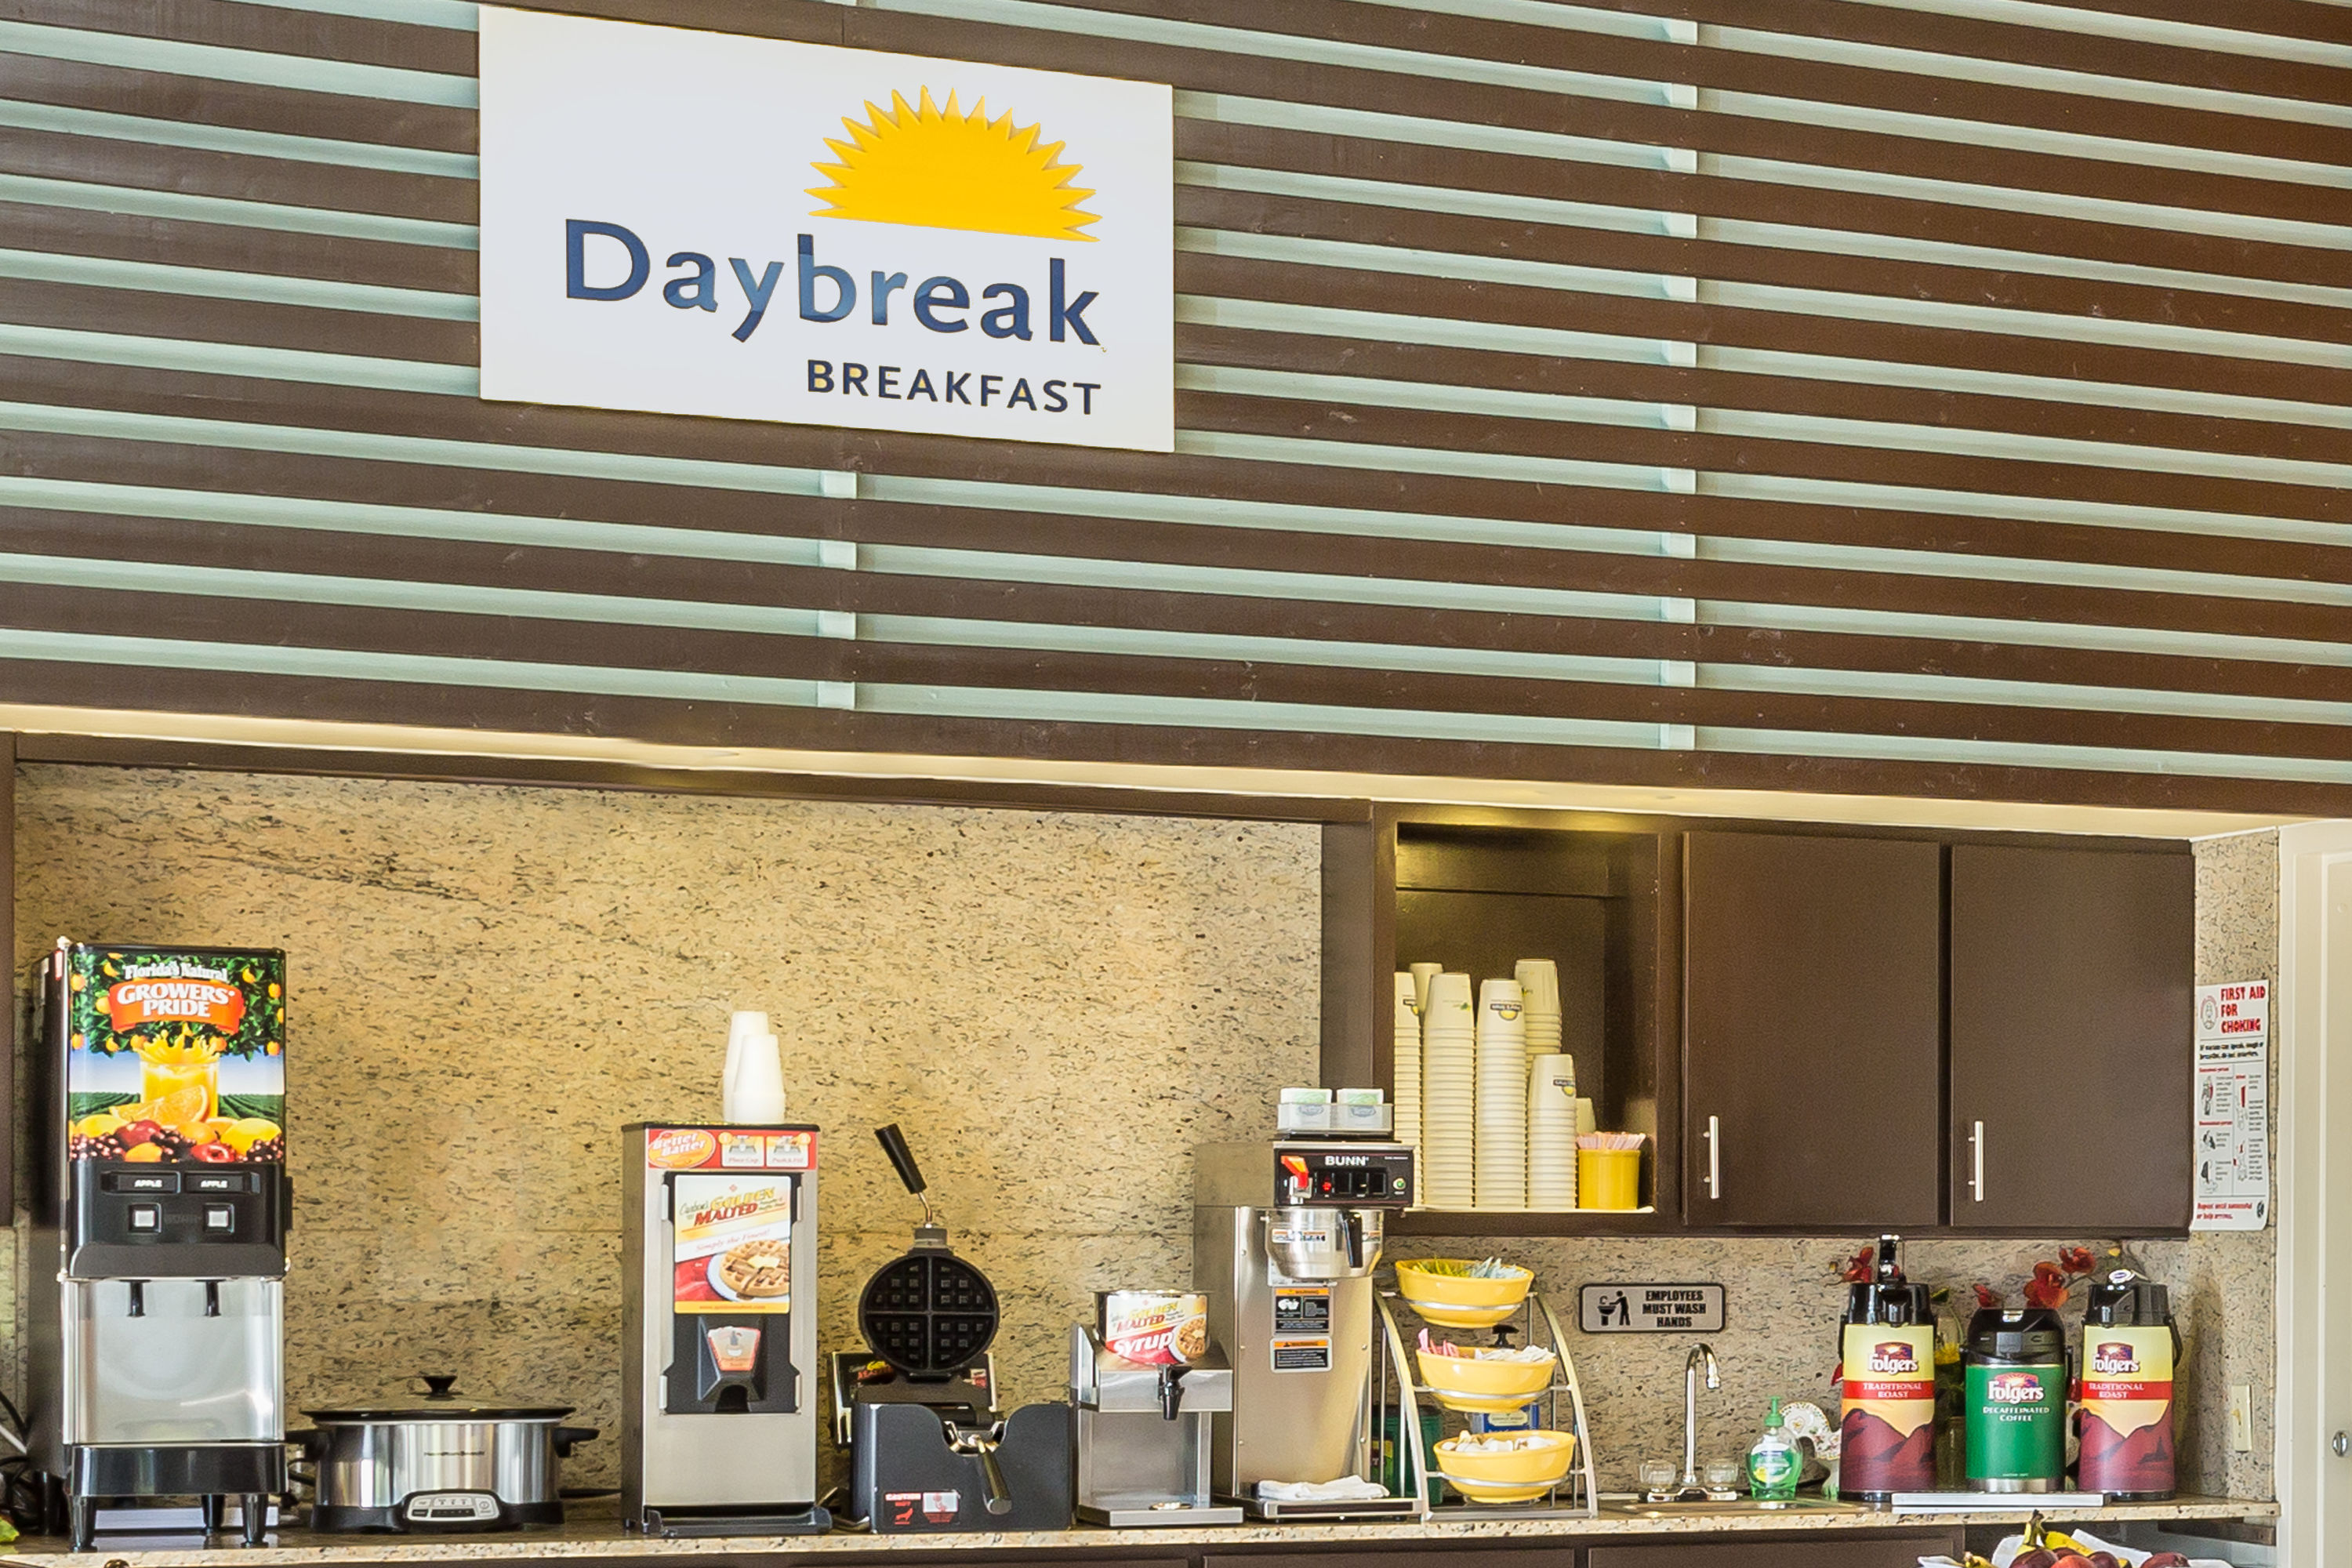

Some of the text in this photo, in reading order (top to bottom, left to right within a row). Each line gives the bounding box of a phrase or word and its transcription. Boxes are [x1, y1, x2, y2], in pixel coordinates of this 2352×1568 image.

[564, 219, 1100, 346] Daybreak
[807, 359, 1102, 416] BREAKFAST
[180, 963, 228, 982] Natural
[2220, 985, 2266, 1001] FIRST AID
[143, 999, 211, 1017] PRIDE
[2220, 1003, 2238, 1018] FOR
[2221, 1018, 2261, 1034] CHOKING
[1325, 1156, 1366, 1166] BUNN
[710, 1187, 775, 1210] GOLDEN
[694, 1203, 758, 1227] MALTED
[1645, 1290, 1704, 1301] EMPLOYEES
[1642, 1303, 1707, 1314] MUST WASH
[1657, 1316, 1693, 1327] HANDS
[1113, 1331, 1174, 1357] Syrup
[1869, 1353, 1918, 1375] Folgers
[2092, 1353, 2140, 1375] Folgers
[1863, 1382, 1922, 1391] TRADITIONAL
[1987, 1381, 2045, 1404] Folgers
[2089, 1382, 2145, 1391] TRADITIONAL
